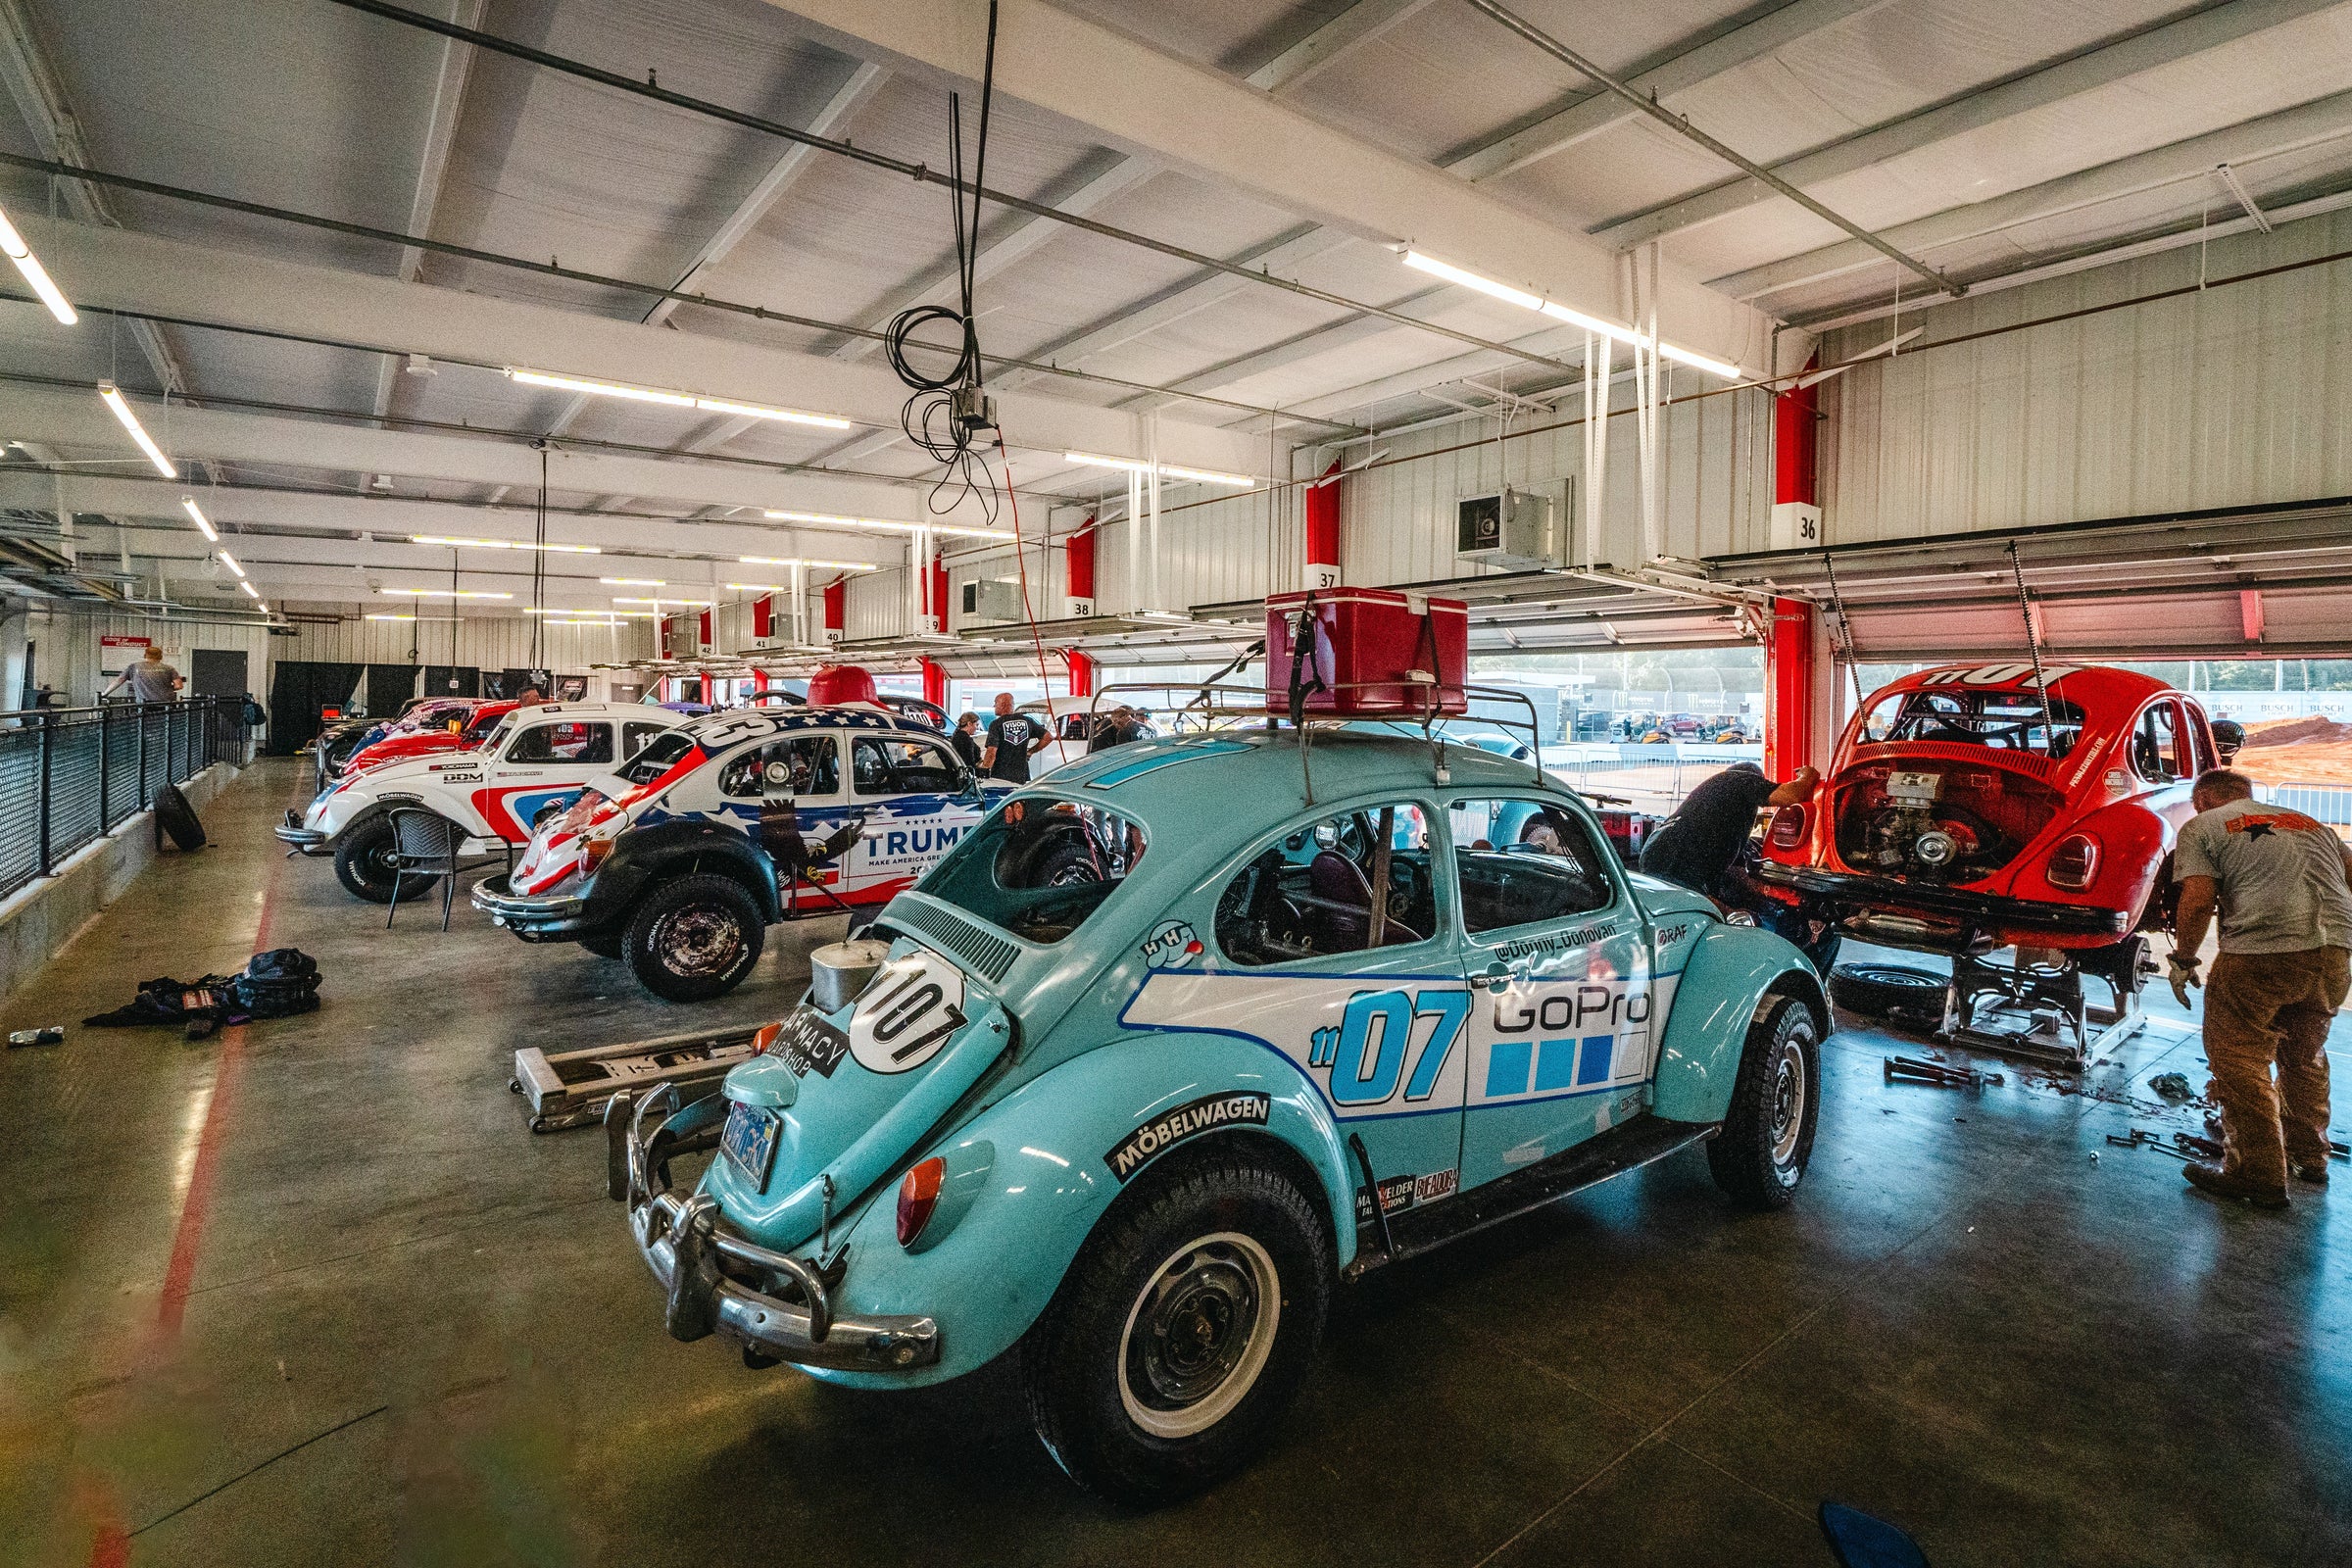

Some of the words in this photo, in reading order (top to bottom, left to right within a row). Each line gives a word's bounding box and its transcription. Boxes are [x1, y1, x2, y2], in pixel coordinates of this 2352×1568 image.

[1800, 516, 1815, 540] 36
[1320, 573, 1335, 588] 37
[1074, 604, 1089, 615] 38
[827, 633, 838, 642] 40
[862, 826, 975, 858] TRUM
[893, 856, 924, 864] AMERICA
[1494, 923, 1617, 962] @Donny_Donovan
[1494, 986, 1650, 1033] GoPro
[1115, 1098, 1268, 1176] MÖBELWAGEN
